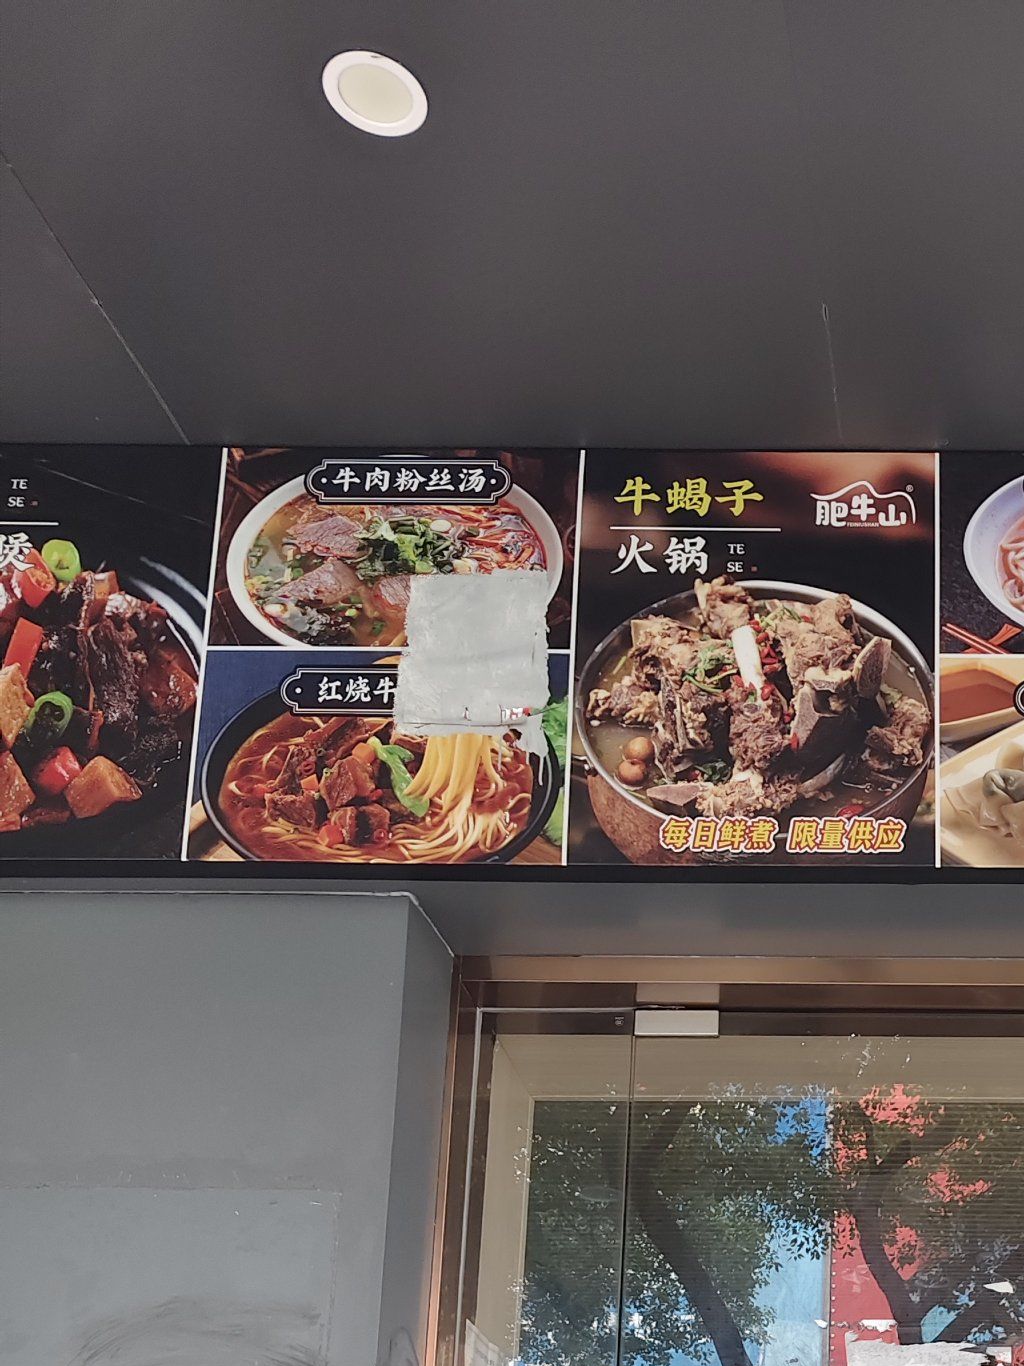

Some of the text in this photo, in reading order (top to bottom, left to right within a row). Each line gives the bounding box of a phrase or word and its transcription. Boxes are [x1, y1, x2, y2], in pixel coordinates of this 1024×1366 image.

[11, 478, 28, 489] TE
[331, 467, 486, 494] 牛肉粉丝汤
[7, 496, 25, 507] SE
[614, 476, 764, 517] 牛蝎子
[815, 493, 907, 527] 肥牛山
[610, 534, 709, 574] 火锅
[727, 543, 745, 555] TE
[726, 562, 744, 573] SE
[662, 818, 903, 851] 每日鲜煮 限量供应
